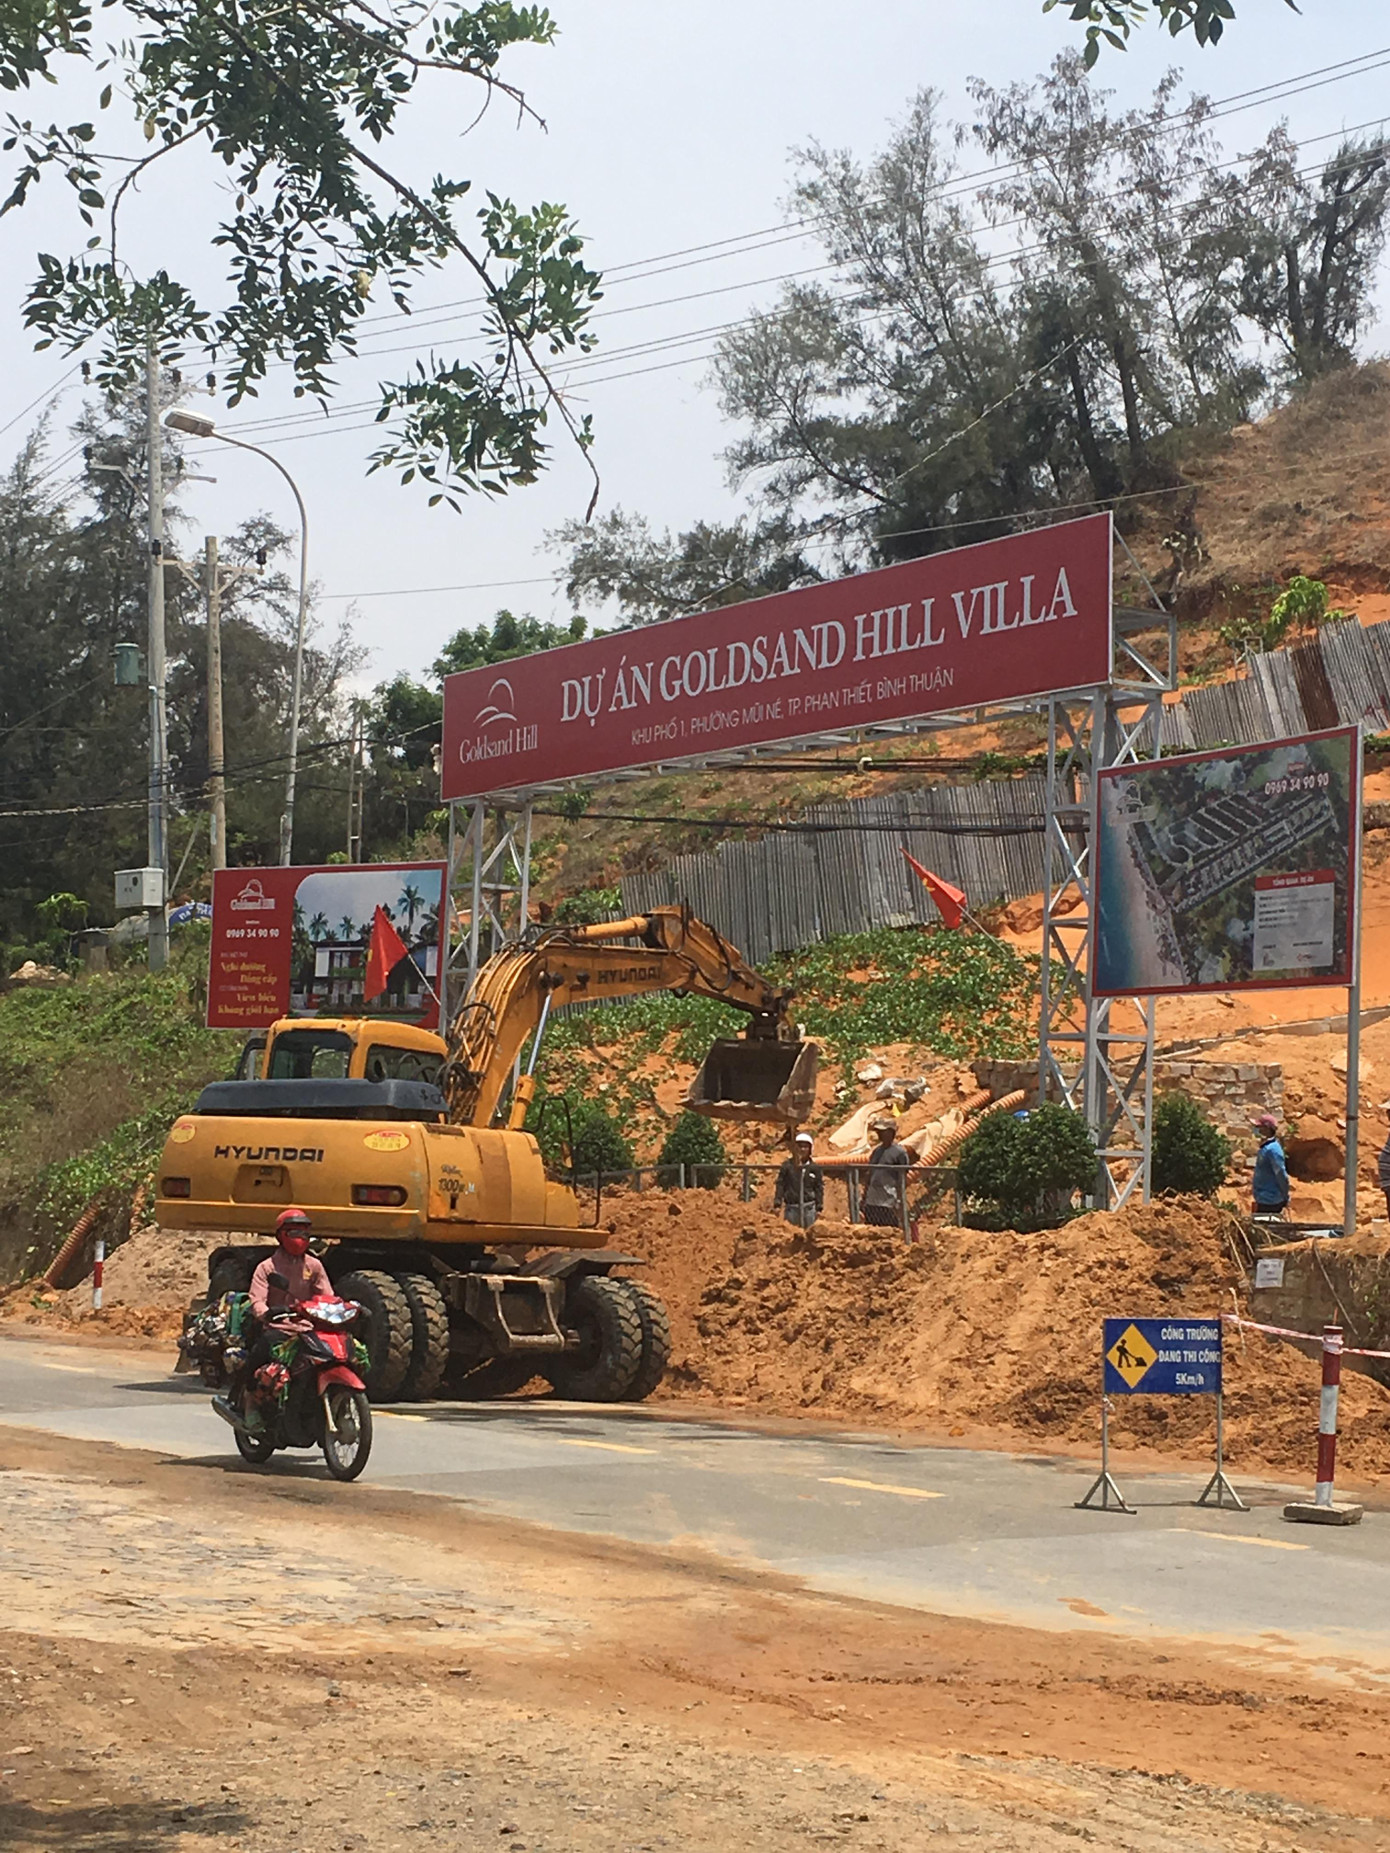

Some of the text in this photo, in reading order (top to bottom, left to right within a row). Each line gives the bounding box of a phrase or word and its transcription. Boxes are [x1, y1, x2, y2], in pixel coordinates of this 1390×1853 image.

[560, 567, 1078, 727] DỰ ÁN GOLDSAND HILL VILLA
[631, 726, 652, 745] KHU
[654, 717, 678, 741] PHỐ
[742, 702, 764, 724] MŨI
[805, 691, 839, 714] PHAN
[877, 677, 906, 700] BÌNH
[909, 666, 954, 693] THUẬN
[460, 724, 538, 764] Goldsand Hill
[597, 967, 662, 984] HYUNDAI
[214, 1145, 324, 1162] HYUNDAI
[1183, 1350, 1197, 1362] THI
